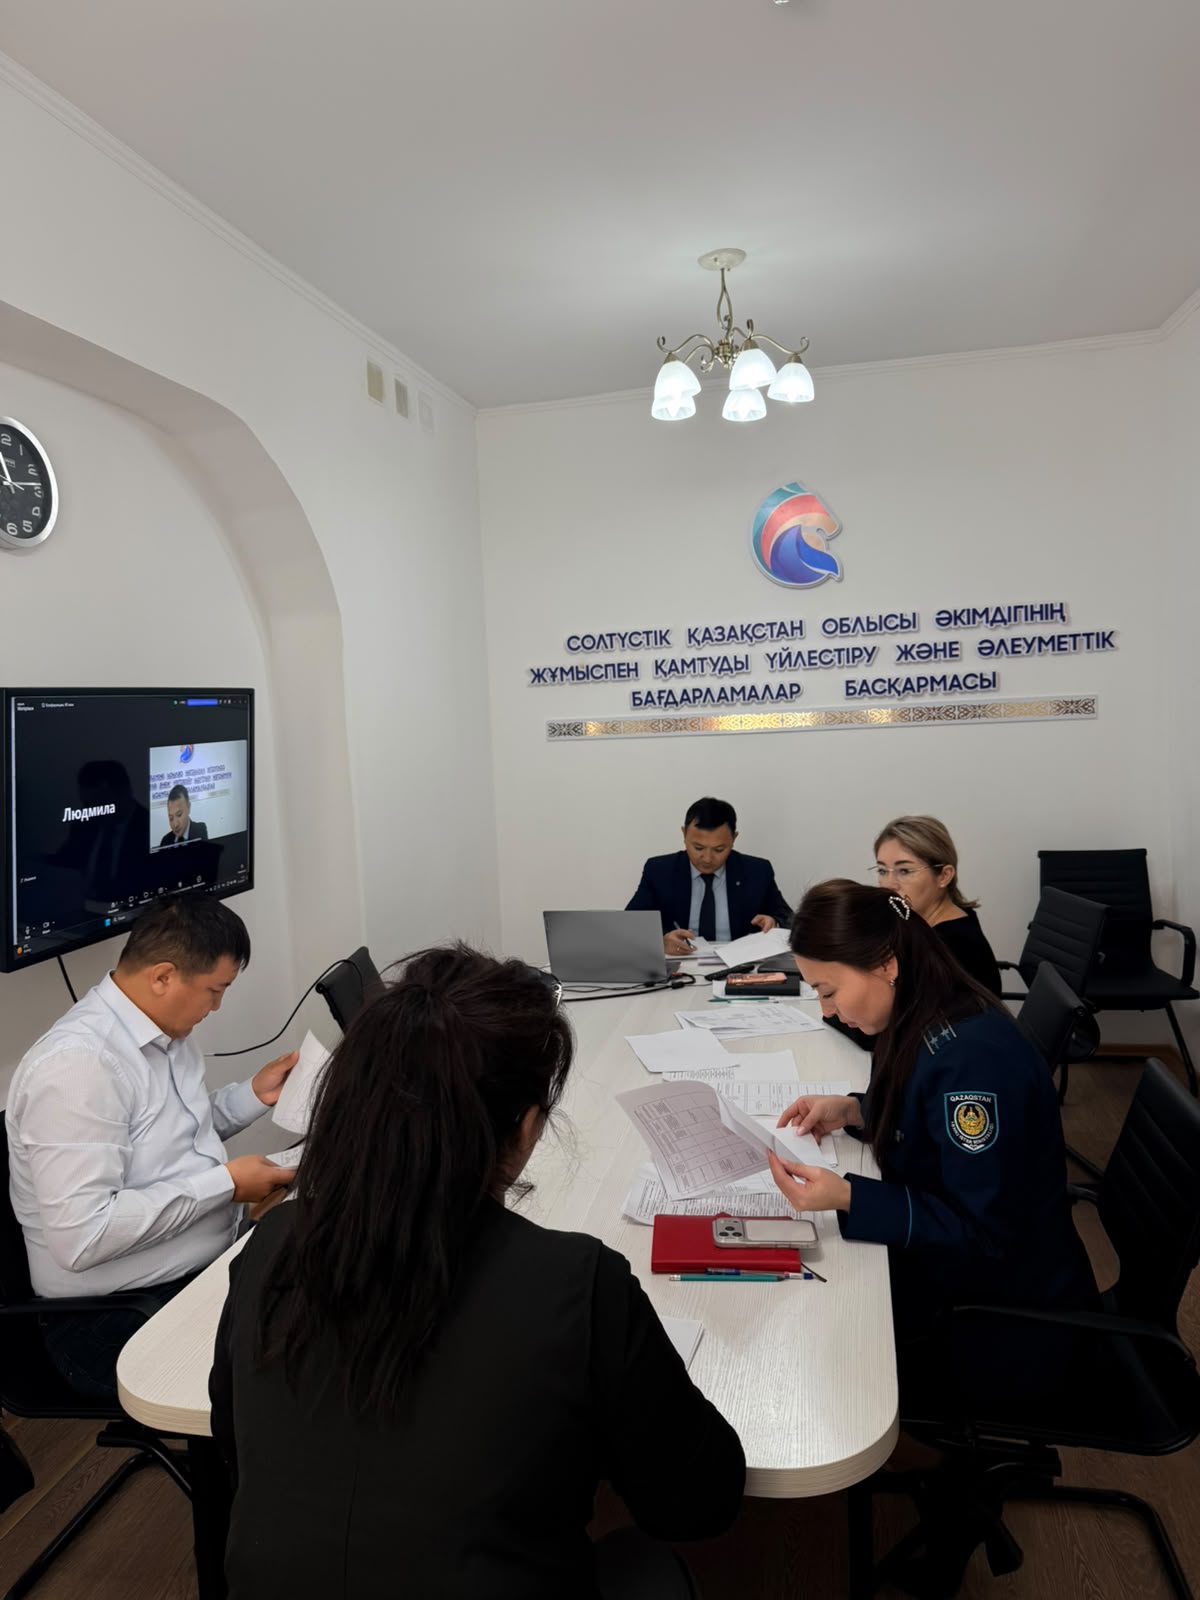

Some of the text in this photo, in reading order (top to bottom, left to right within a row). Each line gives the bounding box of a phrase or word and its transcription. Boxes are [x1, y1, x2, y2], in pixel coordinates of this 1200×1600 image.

[6, 522, 18, 536] 6
[22, 519, 33, 533] 5
[566, 602, 1066, 652] СОЛТҮСТІК ҚАЗАҚСТАН ОБЛЫСЫ ӘКІМДІГІНІҢ
[530, 630, 1115, 684] ЖҰМЫСПЕН ҚАМТУДЫ ҮЙЛЕСТІРУ ЖӘНЕ ӘЛЕУМЕТТІК
[631, 671, 997, 708] БАҒДАРЛАМАЛАР БАСҚАРМАСЫ
[62, 804, 115, 822] Людмила
[950, 1094, 991, 1103] QAZAQSTAN
